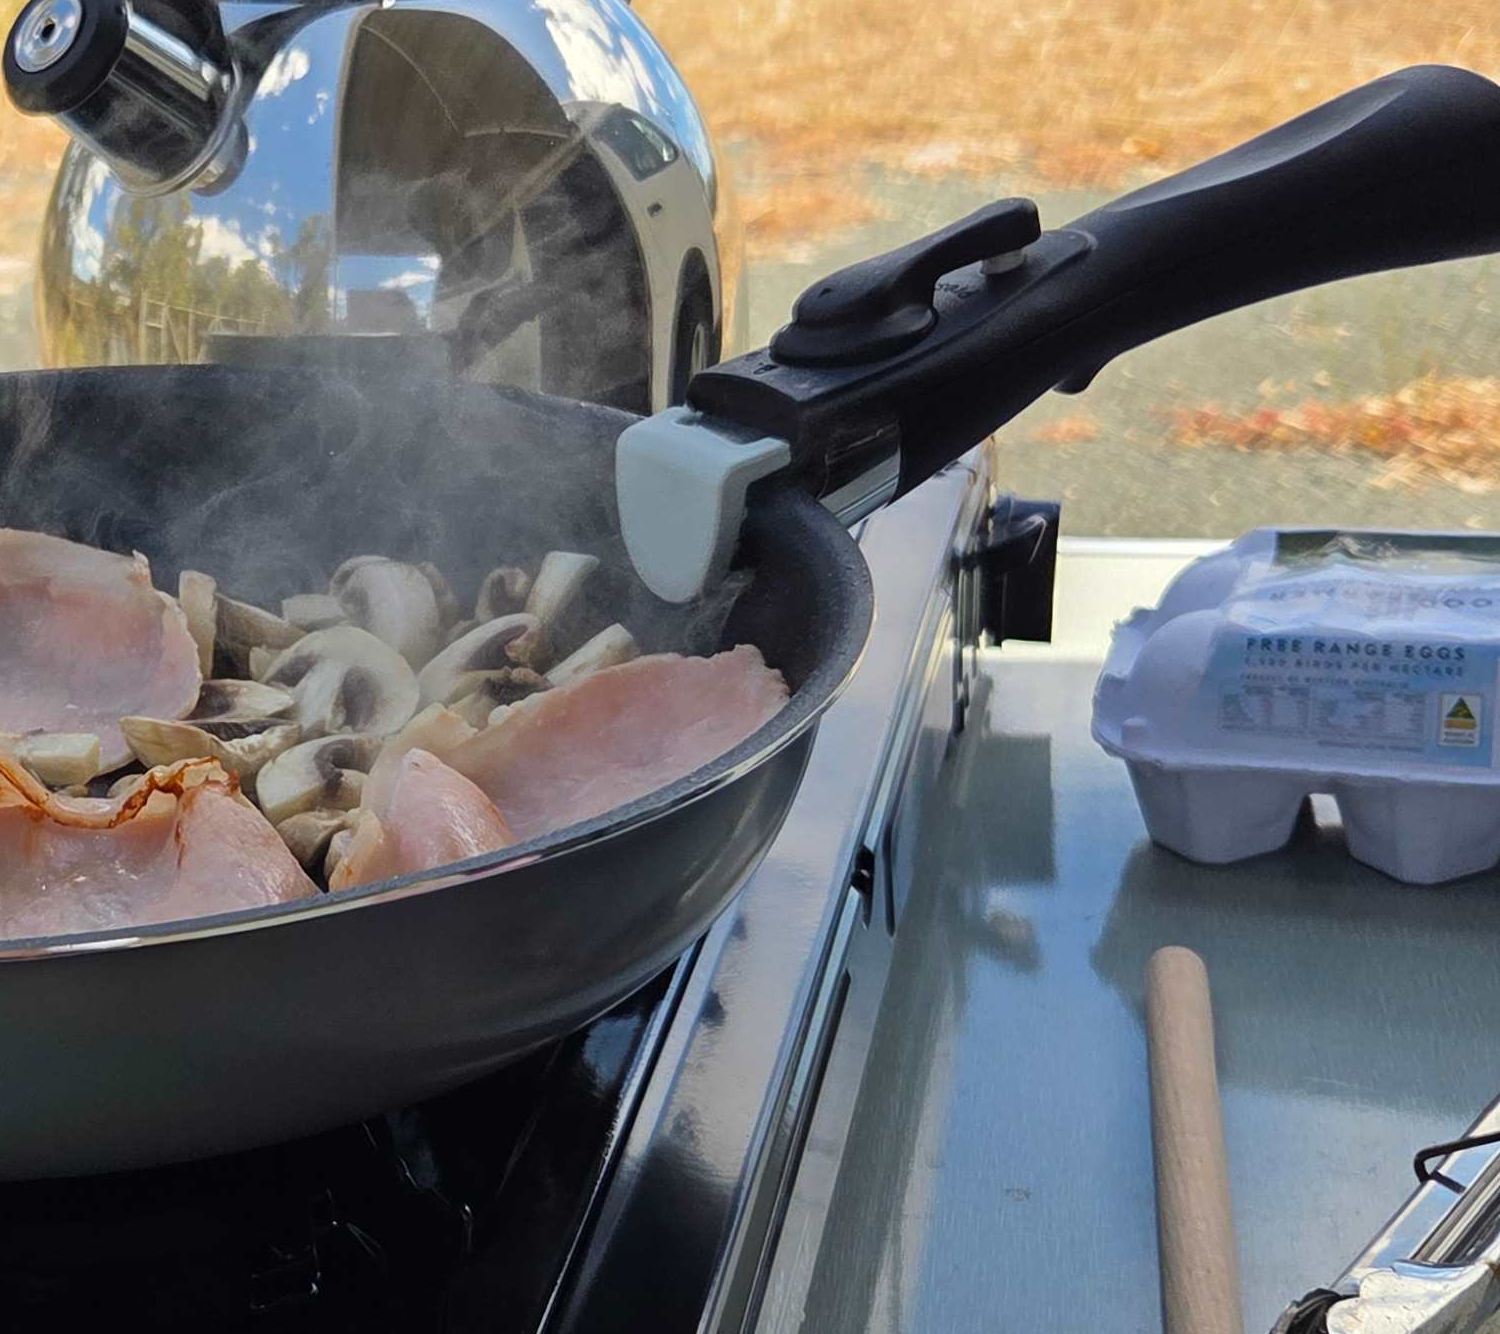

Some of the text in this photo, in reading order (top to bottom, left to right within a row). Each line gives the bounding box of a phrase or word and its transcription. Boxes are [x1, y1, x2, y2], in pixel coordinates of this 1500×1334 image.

[1247, 638, 1465, 661] FREE RANGE EGGS
